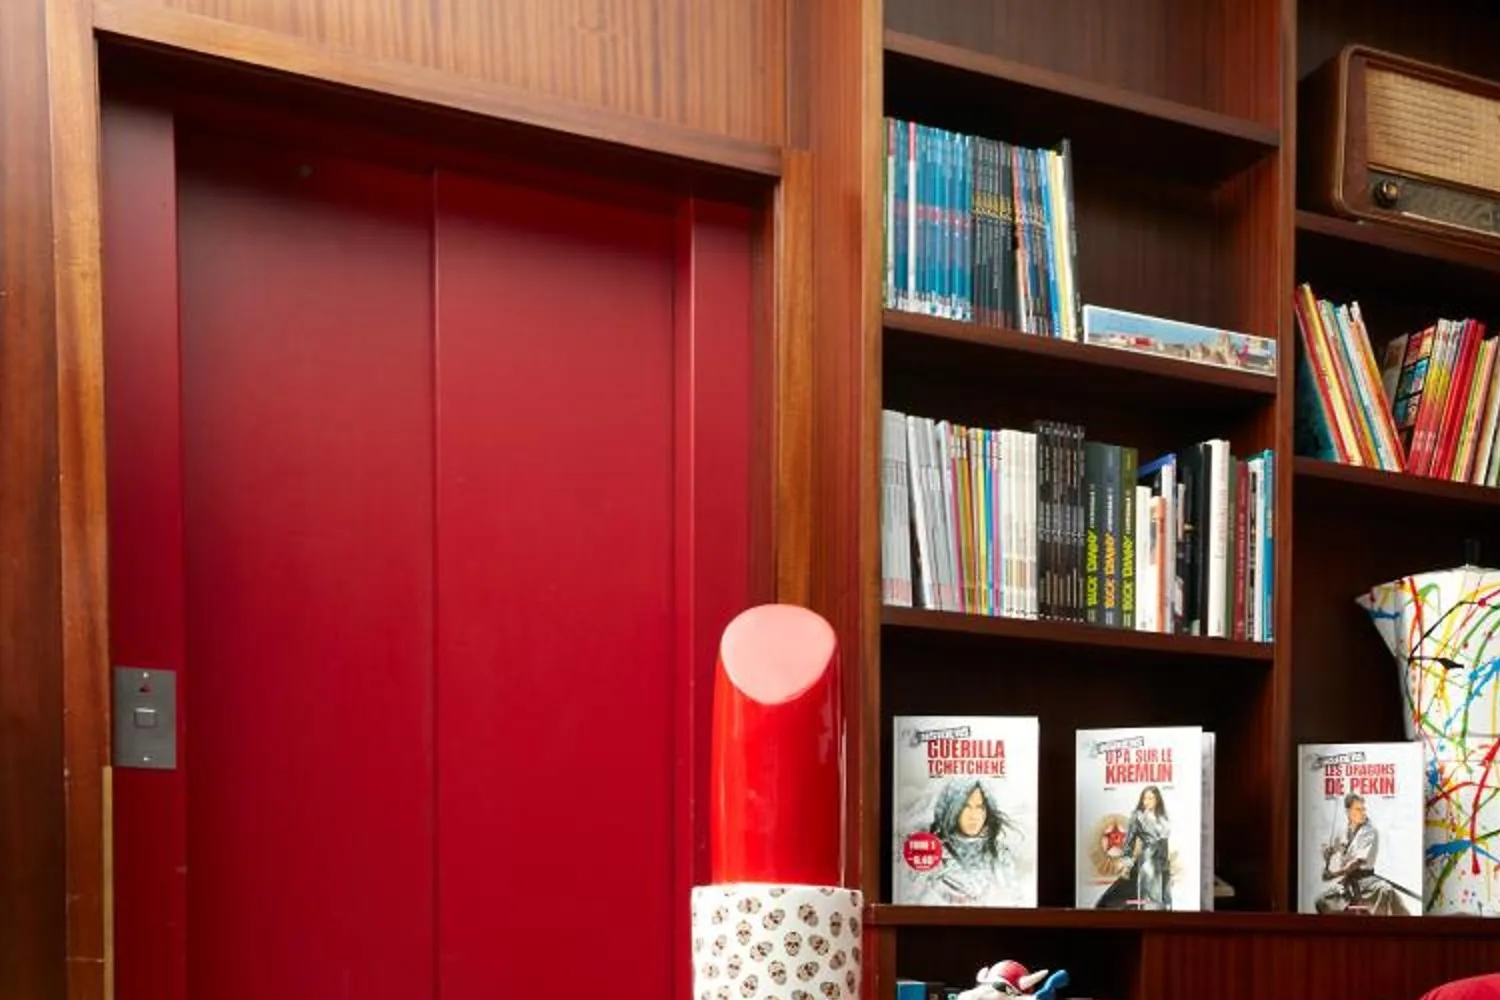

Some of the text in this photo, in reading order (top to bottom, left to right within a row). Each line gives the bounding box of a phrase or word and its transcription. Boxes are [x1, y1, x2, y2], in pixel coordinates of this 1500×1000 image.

[927, 738, 1005, 758] GUERILLA
[1135, 748, 1159, 763] SUR
[1161, 747, 1173, 763] LE
[1105, 763, 1173, 784] KREMLIN
[1325, 763, 1396, 777] LES DRAGONS
[1325, 776, 1395, 796] DE PEKIN
